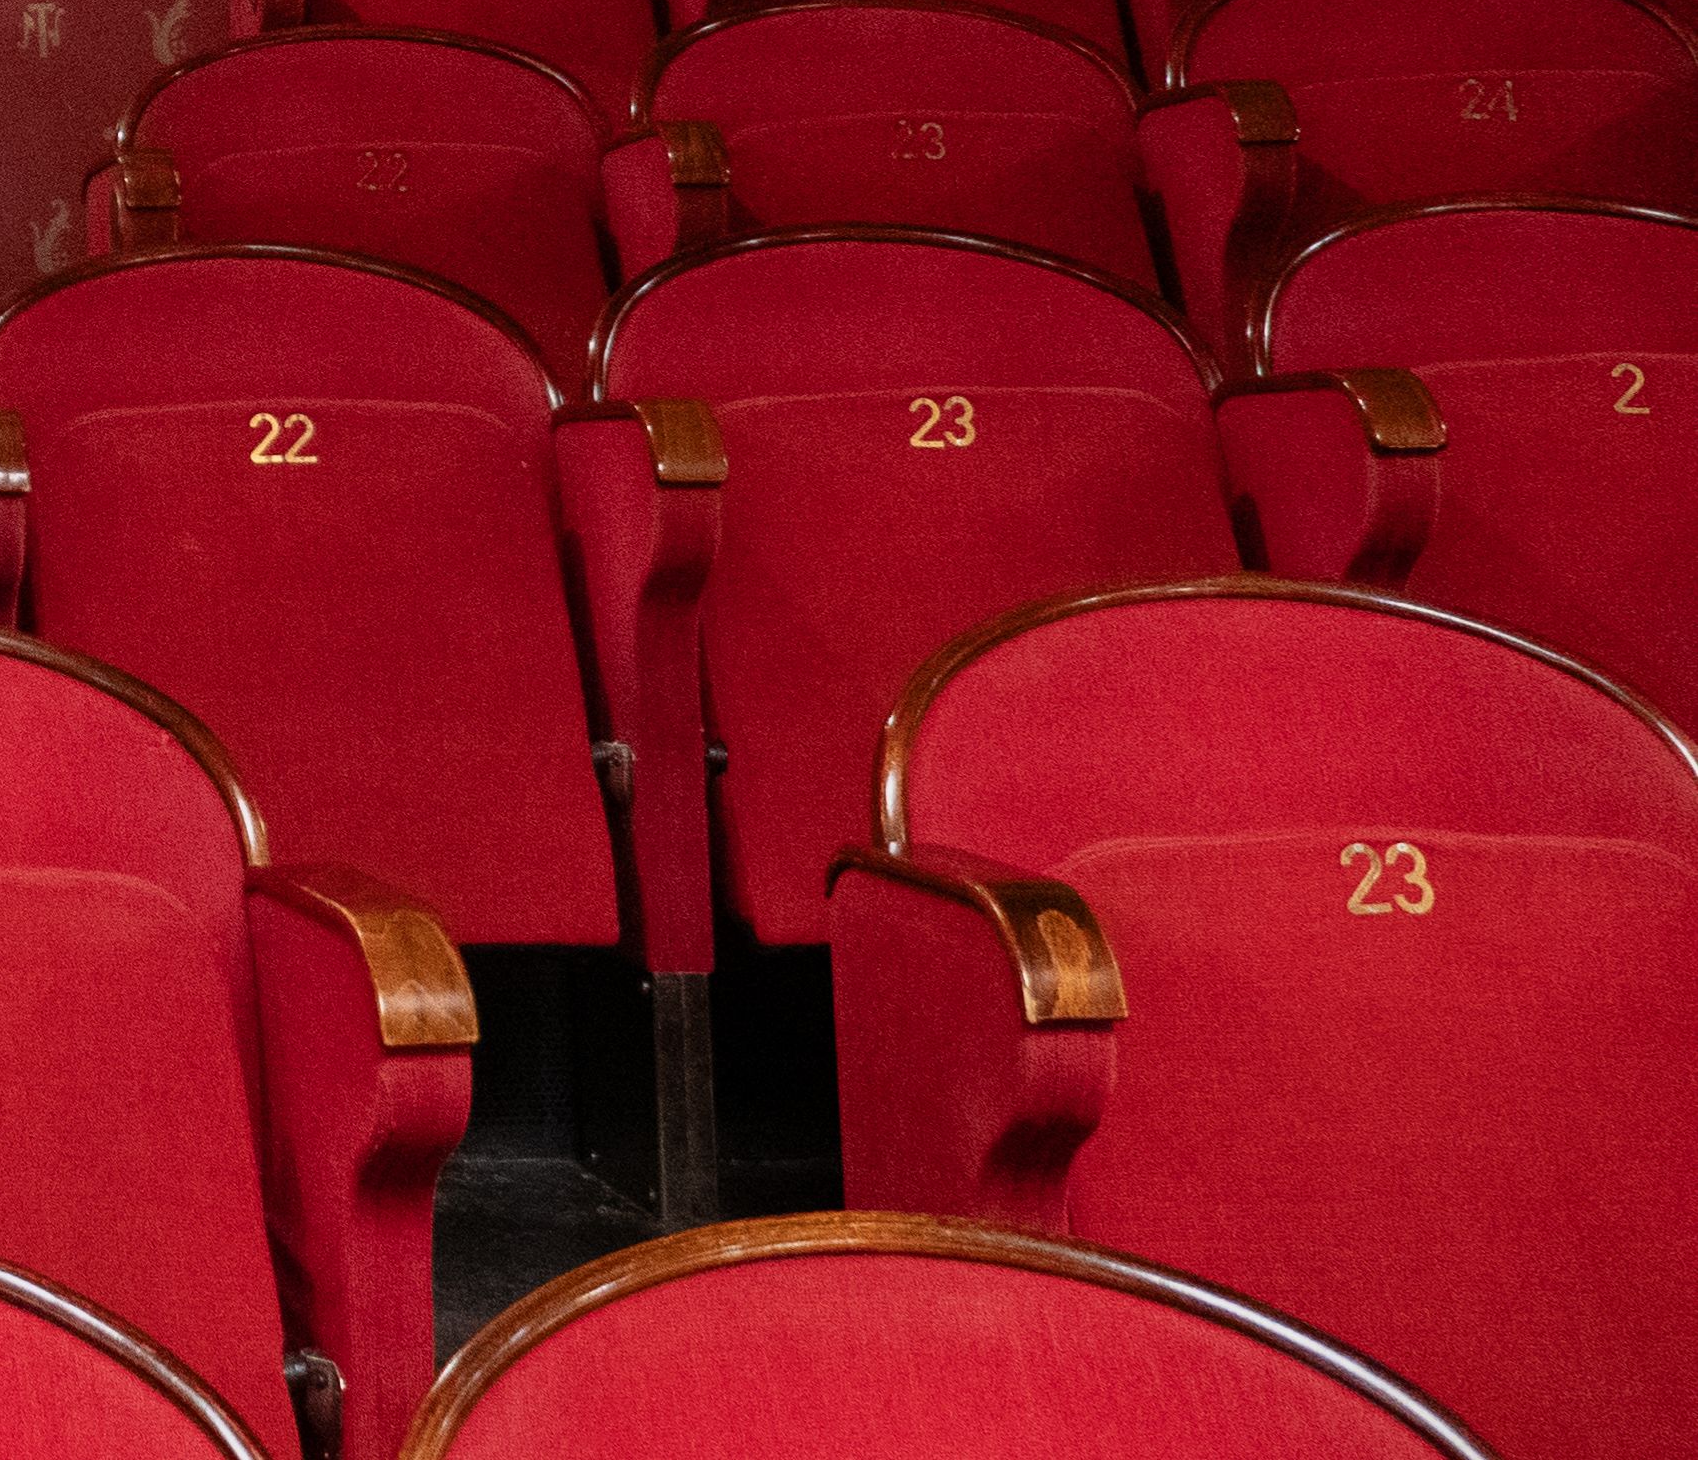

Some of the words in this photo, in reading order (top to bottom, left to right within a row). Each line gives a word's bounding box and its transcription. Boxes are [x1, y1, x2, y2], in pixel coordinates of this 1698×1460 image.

[1458, 78, 1519, 122] 24
[890, 120, 946, 161] 23
[355, 150, 409, 192] 22
[1610, 363, 1651, 415] 2
[248, 412, 319, 464] 22
[908, 395, 977, 449] 23
[1339, 841, 1436, 915] 23
